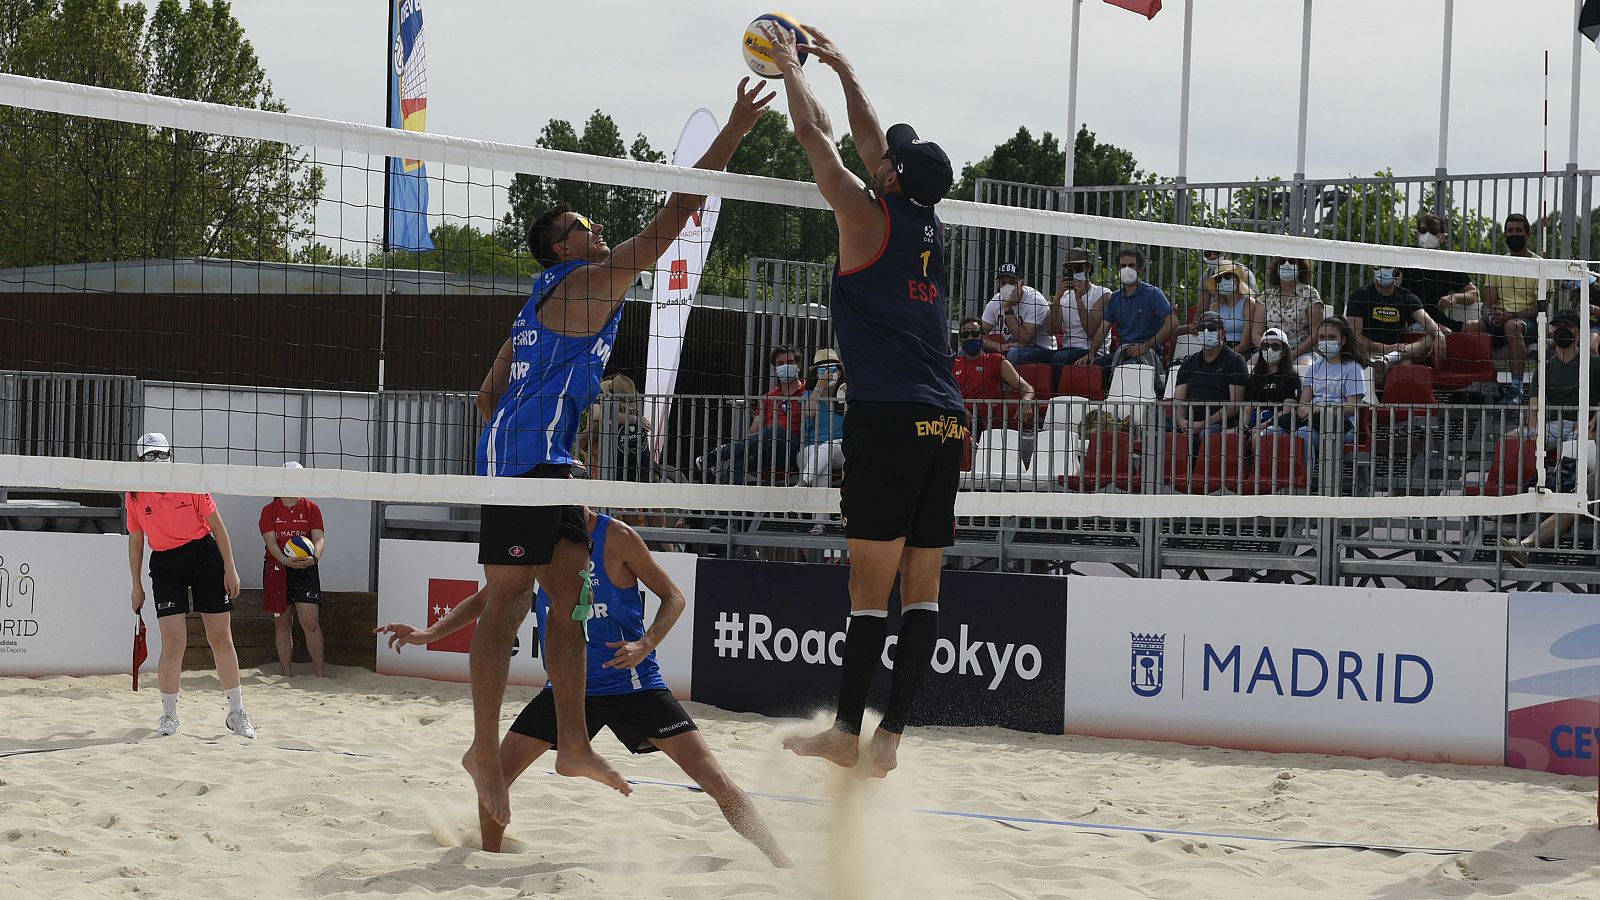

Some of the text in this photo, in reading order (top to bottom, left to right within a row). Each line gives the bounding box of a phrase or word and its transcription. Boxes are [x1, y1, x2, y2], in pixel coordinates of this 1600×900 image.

[920, 250, 932, 278] 1
[908, 279, 939, 305] ESP
[0, 619, 39, 637] RID
[1202, 643, 1434, 704] MADRID
